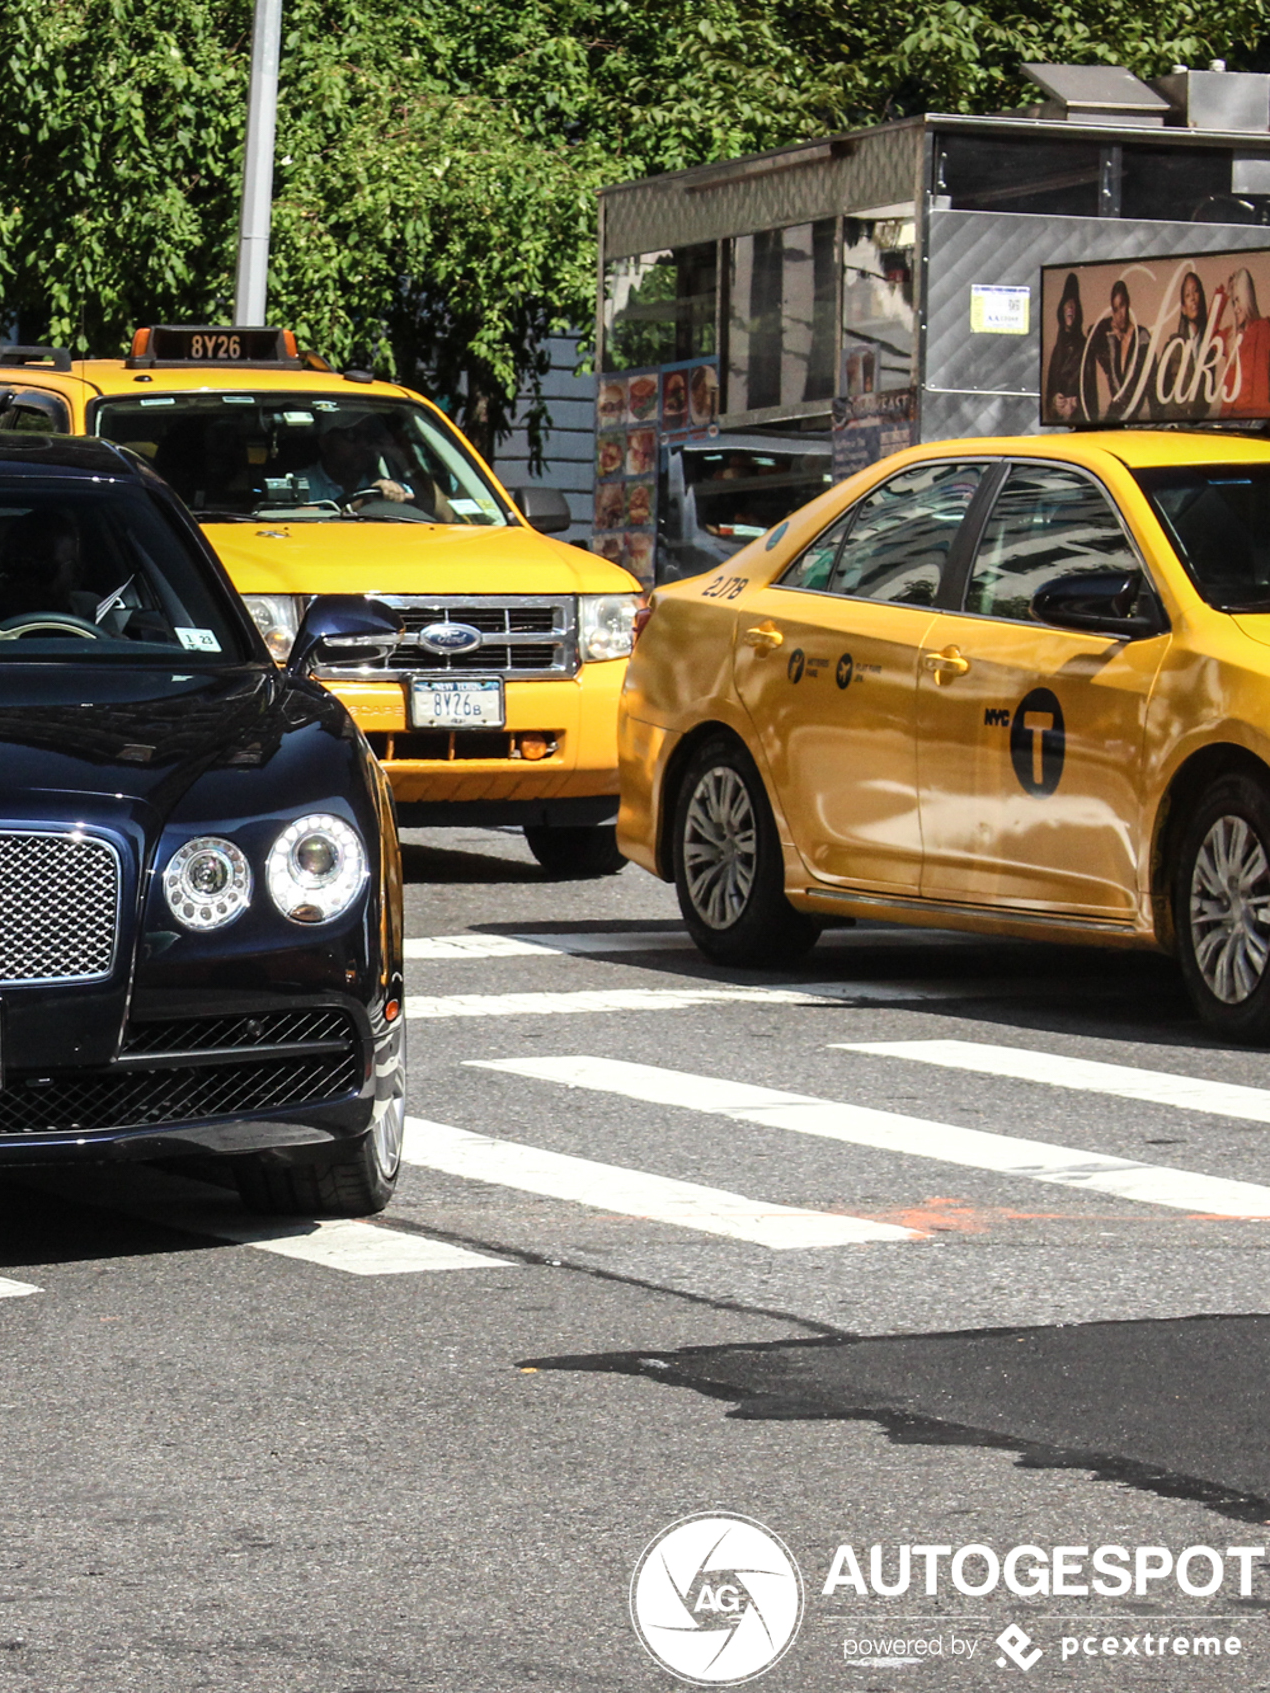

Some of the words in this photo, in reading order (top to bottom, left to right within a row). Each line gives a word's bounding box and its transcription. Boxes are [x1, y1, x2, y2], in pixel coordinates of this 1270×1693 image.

[191, 334, 241, 359] 8Y26
[1081, 260, 1244, 421] Saks
[701, 575, 749, 599] 2J78
[437, 630, 467, 643] Ford
[984, 708, 1010, 727] NYC
